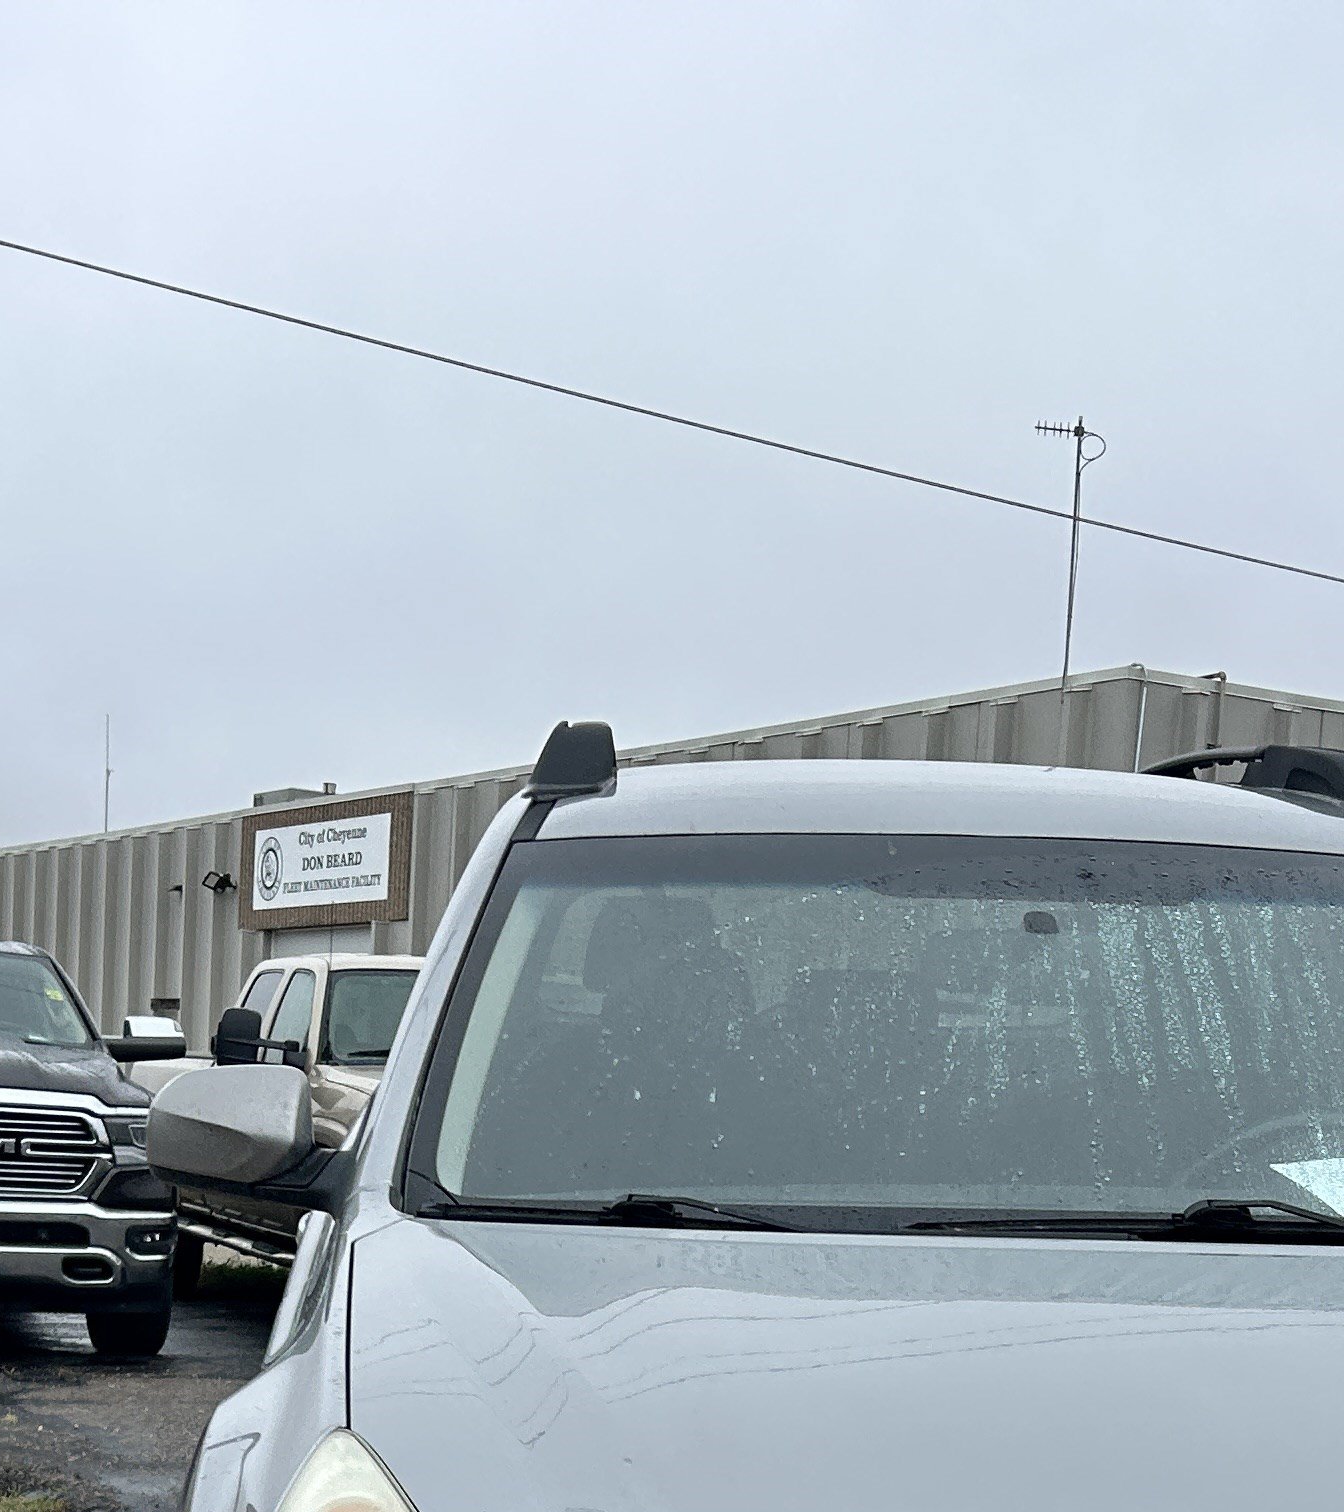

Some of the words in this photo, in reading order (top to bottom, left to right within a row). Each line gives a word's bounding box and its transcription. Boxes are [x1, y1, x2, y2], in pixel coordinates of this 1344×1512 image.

[298, 831, 315, 848] City
[317, 829, 326, 844] of
[327, 827, 367, 844] Cheyenne
[302, 855, 324, 871] DON
[326, 851, 362, 869] BEARD
[303, 877, 350, 892] MAINTENANCE
[351, 874, 382, 888] FACILITY
